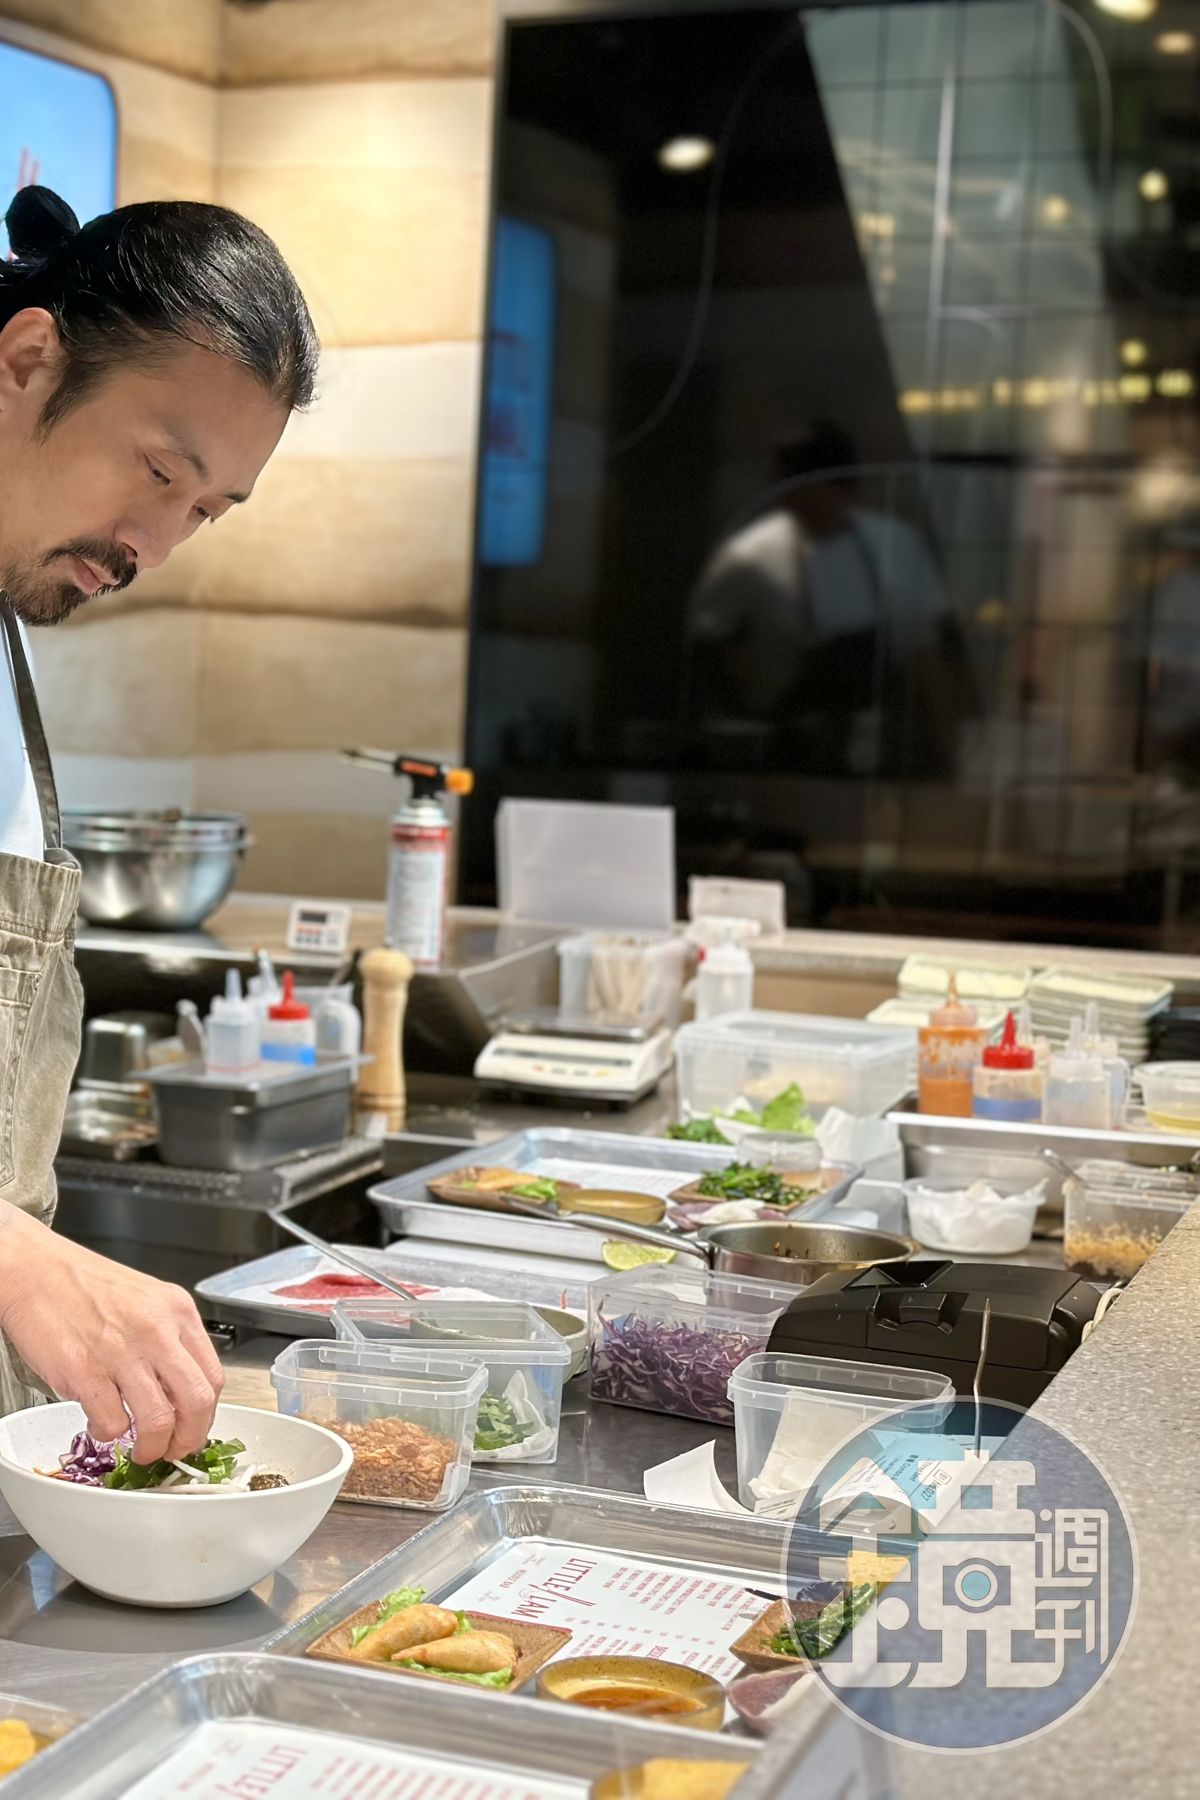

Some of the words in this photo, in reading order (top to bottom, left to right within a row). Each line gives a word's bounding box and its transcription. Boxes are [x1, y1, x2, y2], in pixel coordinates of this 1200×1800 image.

[542, 1558, 597, 1591] LITTLE
[511, 1594, 557, 1619] LAM
[234, 1745, 306, 1794] LITTLE
